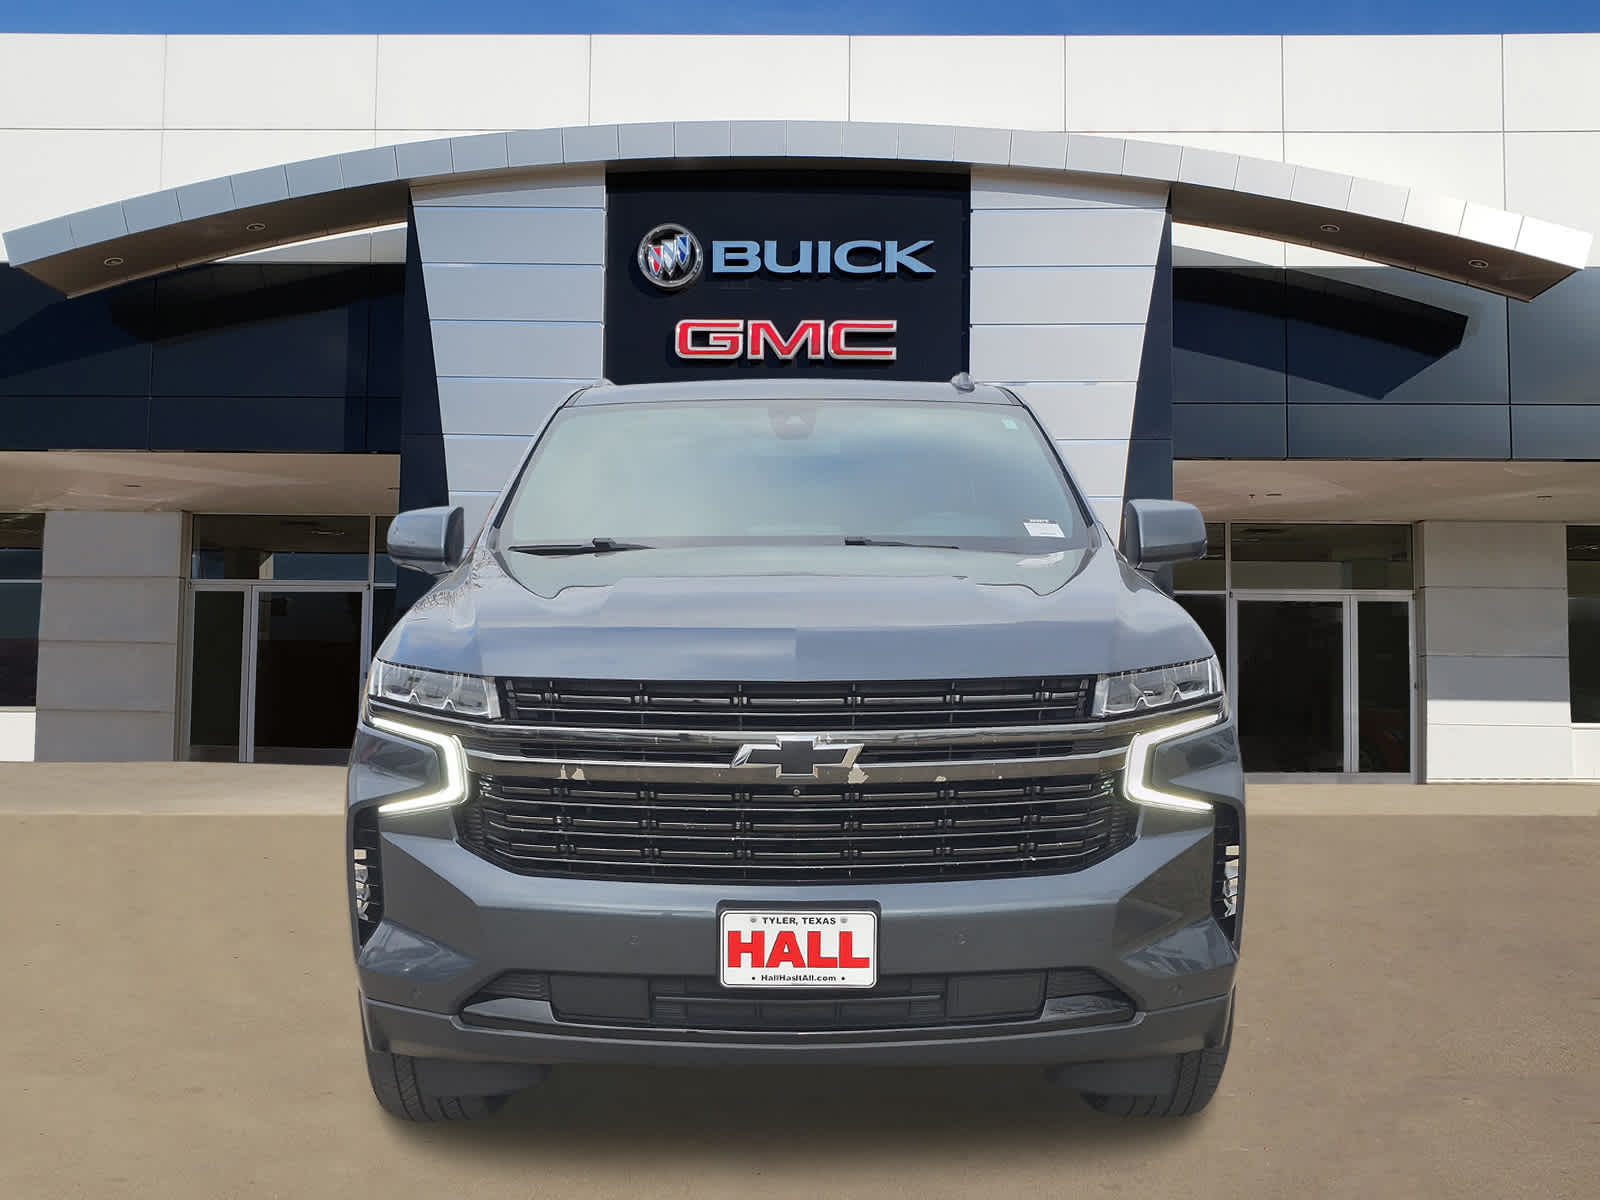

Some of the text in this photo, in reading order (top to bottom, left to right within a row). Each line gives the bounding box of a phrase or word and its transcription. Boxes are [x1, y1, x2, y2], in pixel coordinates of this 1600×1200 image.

[711, 239, 937, 274] BUICK
[674, 318, 898, 361] GMC
[762, 917, 837, 926] TYLER, TEXAS
[727, 930, 870, 968] HALL
[760, 974, 837, 982] HallHasItAll.com
